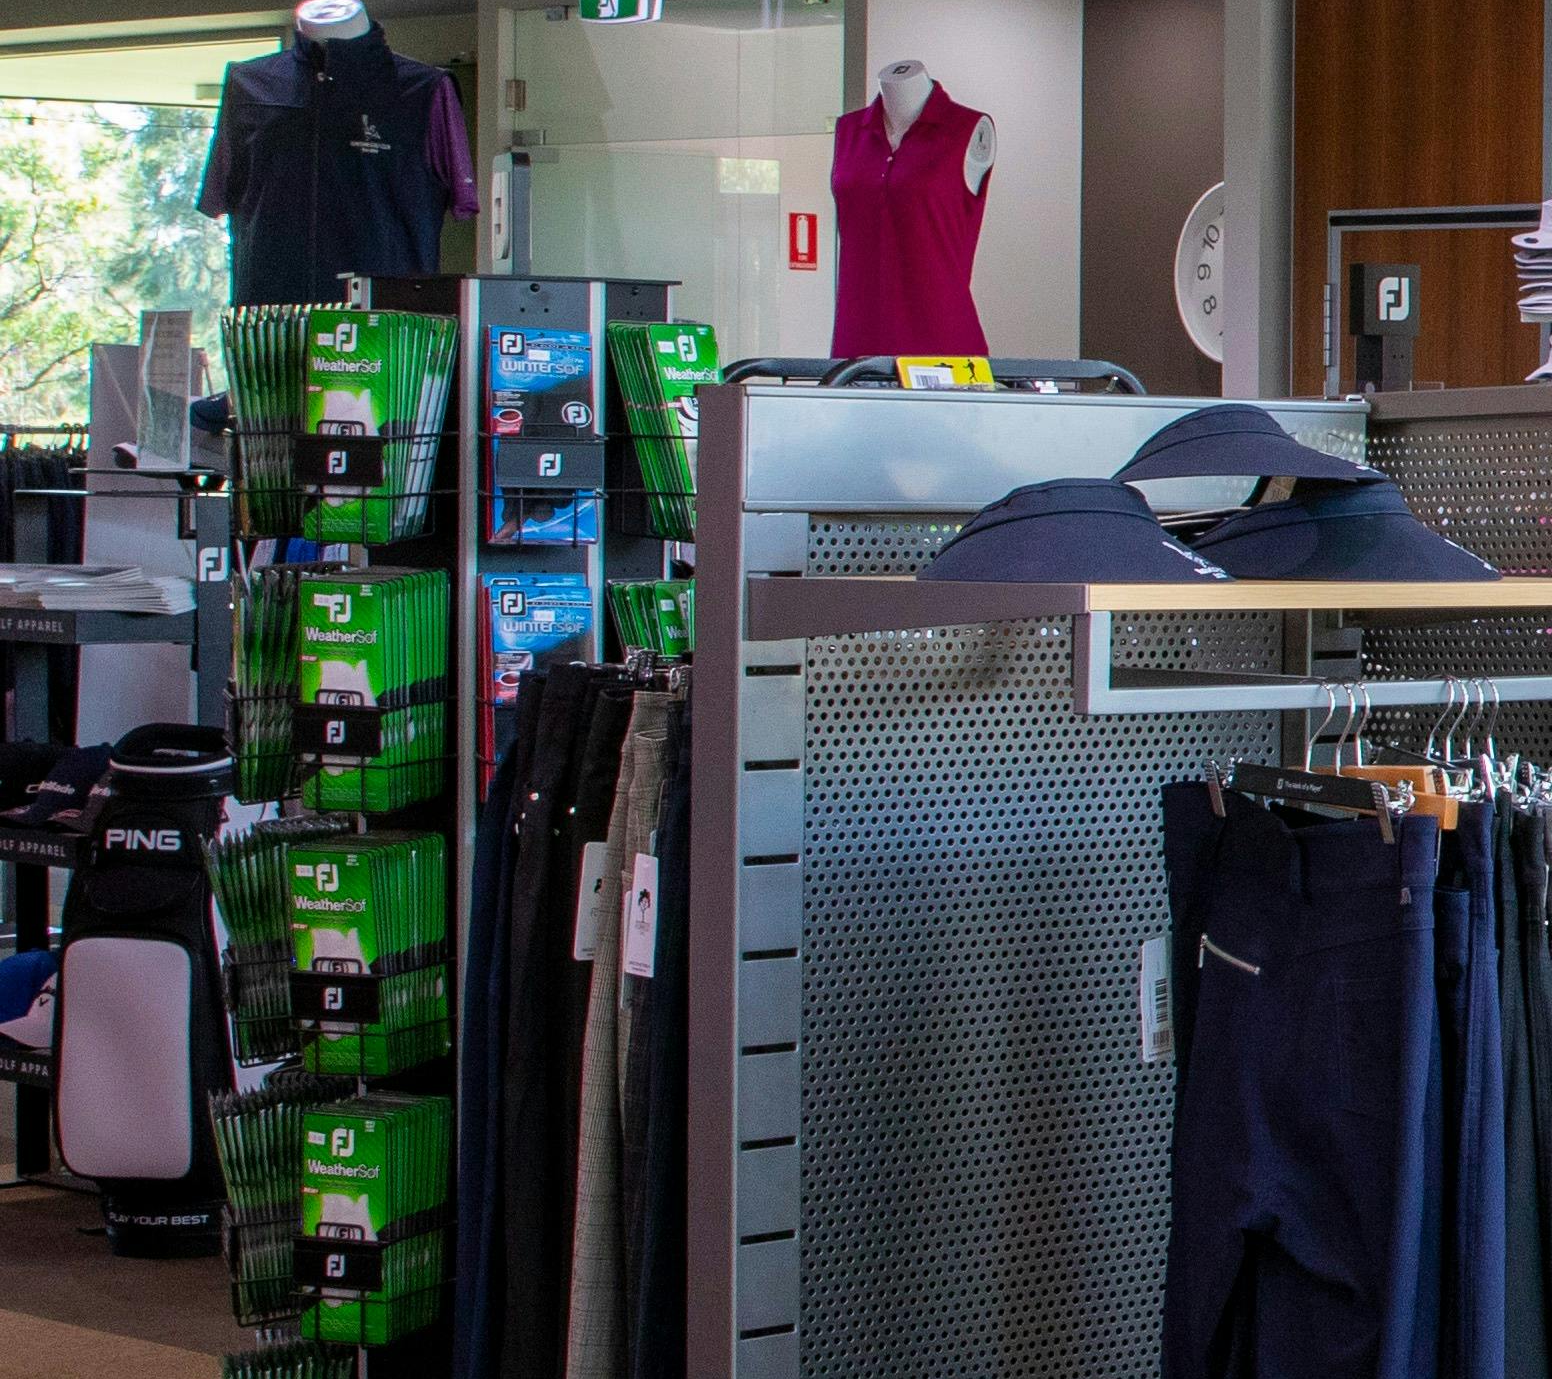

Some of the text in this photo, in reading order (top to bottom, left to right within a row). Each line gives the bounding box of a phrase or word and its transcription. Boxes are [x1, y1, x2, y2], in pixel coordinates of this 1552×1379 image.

[1203, 224, 1221, 251] 10
[1196, 263, 1212, 280] 9
[1202, 295, 1218, 315] 8
[1378, 276, 1410, 321] FJ
[336, 323, 357, 352] FJ
[501, 333, 523, 353] FJ
[678, 335, 698, 362] FJ
[312, 357, 383, 374] WeatherSof
[328, 451, 347, 474] FJ
[538, 453, 562, 477] FJ
[200, 547, 229, 581] FJ
[329, 594, 352, 623] FJ
[502, 593, 523, 615] FJ
[17, 619, 65, 633] APPAREL
[305, 626, 378, 645] WeatherSof
[326, 721, 346, 744] FJ
[106, 829, 182, 852] PING
[316, 864, 340, 892] FJ
[294, 895, 367, 913] WeatherSof
[324, 986, 343, 1010] FJ
[331, 1127, 355, 1157] FJ
[308, 1158, 380, 1178] WeatherSof
[170, 1214, 209, 1226] BEST
[326, 1254, 346, 1278] FJ
